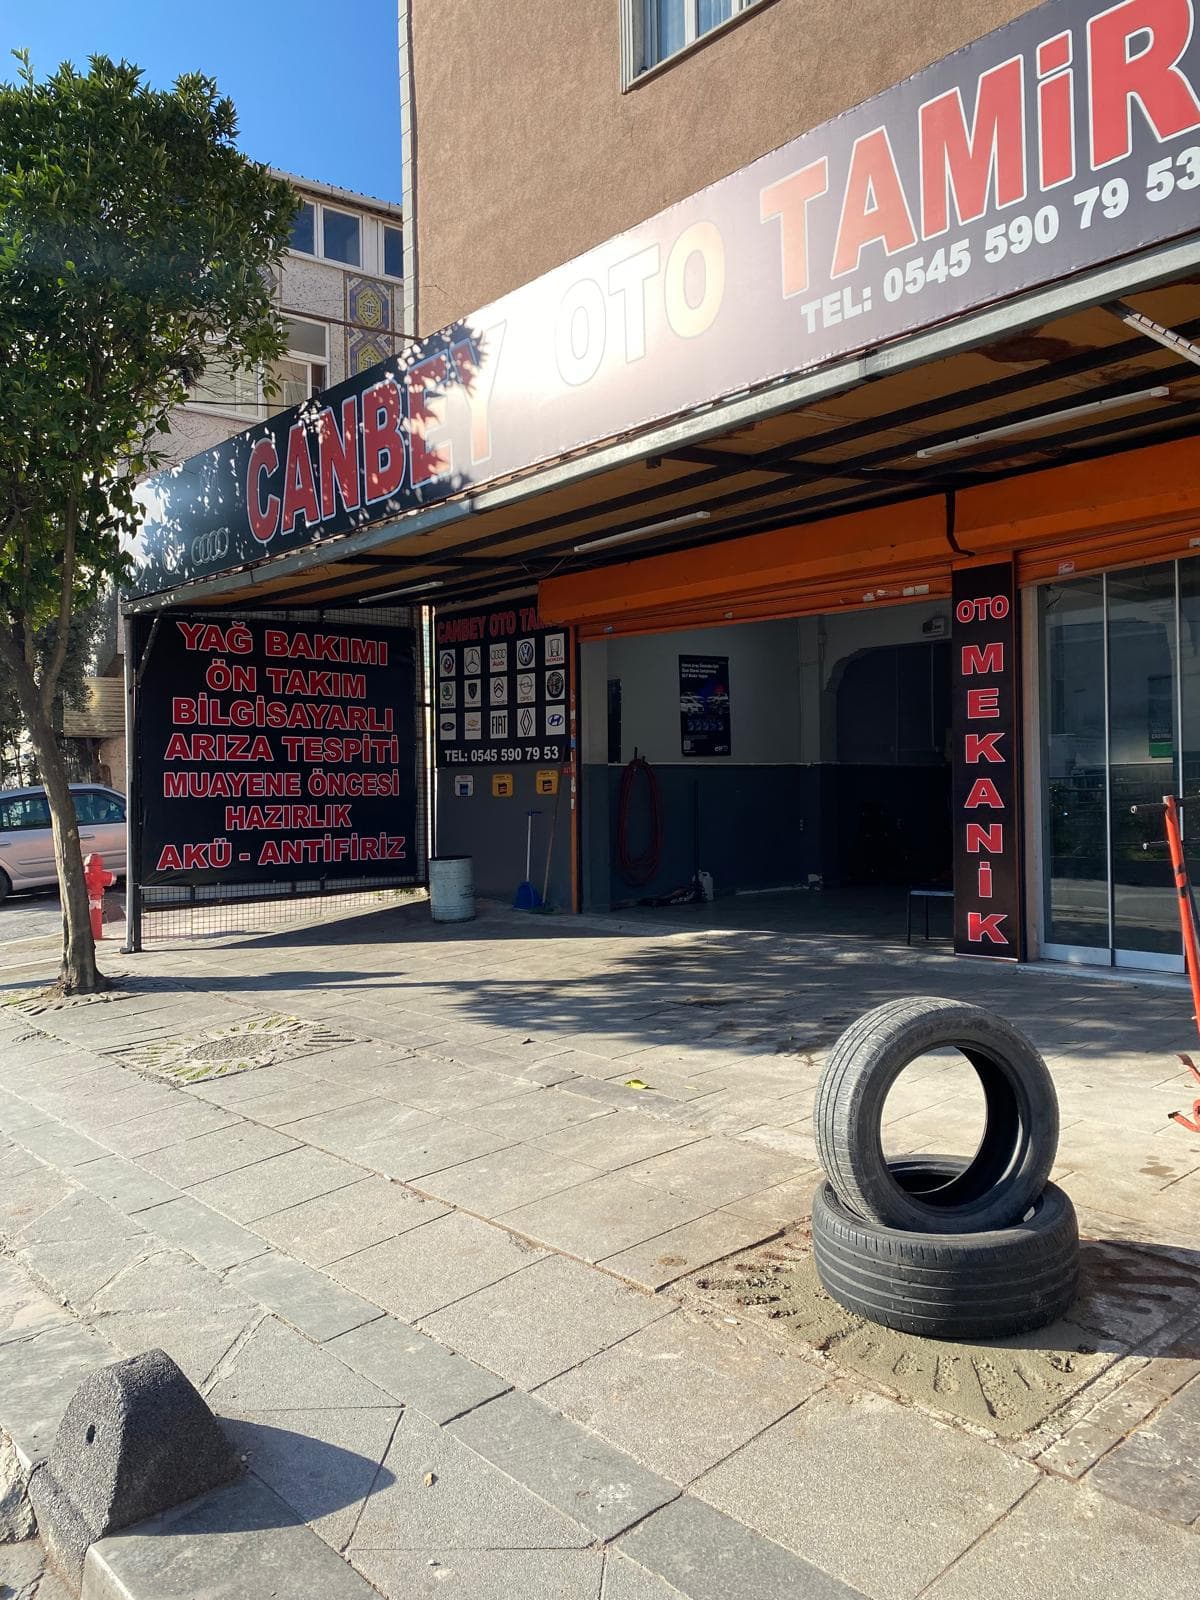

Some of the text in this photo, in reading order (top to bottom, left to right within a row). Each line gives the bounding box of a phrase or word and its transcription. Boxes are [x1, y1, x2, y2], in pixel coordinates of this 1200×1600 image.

[800, 146, 1200, 334] TEL: 0545 590 79 53
[246, 319, 507, 543] CANBEY
[556, 220, 725, 387] OTO
[437, 616, 486, 644] CANBEY
[490, 610, 517, 637] OTO
[956, 595, 1010, 623] OTO
[176, 620, 388, 666] YAĞ BAKIMI
[206, 659, 366, 699] ÖN TAKIM
[172, 692, 393, 732] BİLGİSAYARLI
[492, 715, 507, 734] FIAT
[164, 733, 399, 764] ARIZA TESPİTİ
[444, 745, 559, 762] TEL: 0545 590 79 53
[164, 768, 400, 798] MUAYENE ÖNCESİ
[961, 642, 1010, 945] MEKANİK
[225, 804, 352, 831] HAZIRLIK
[156, 838, 232, 870] AKÜ
[258, 832, 406, 866] ANTİFİRİZ
